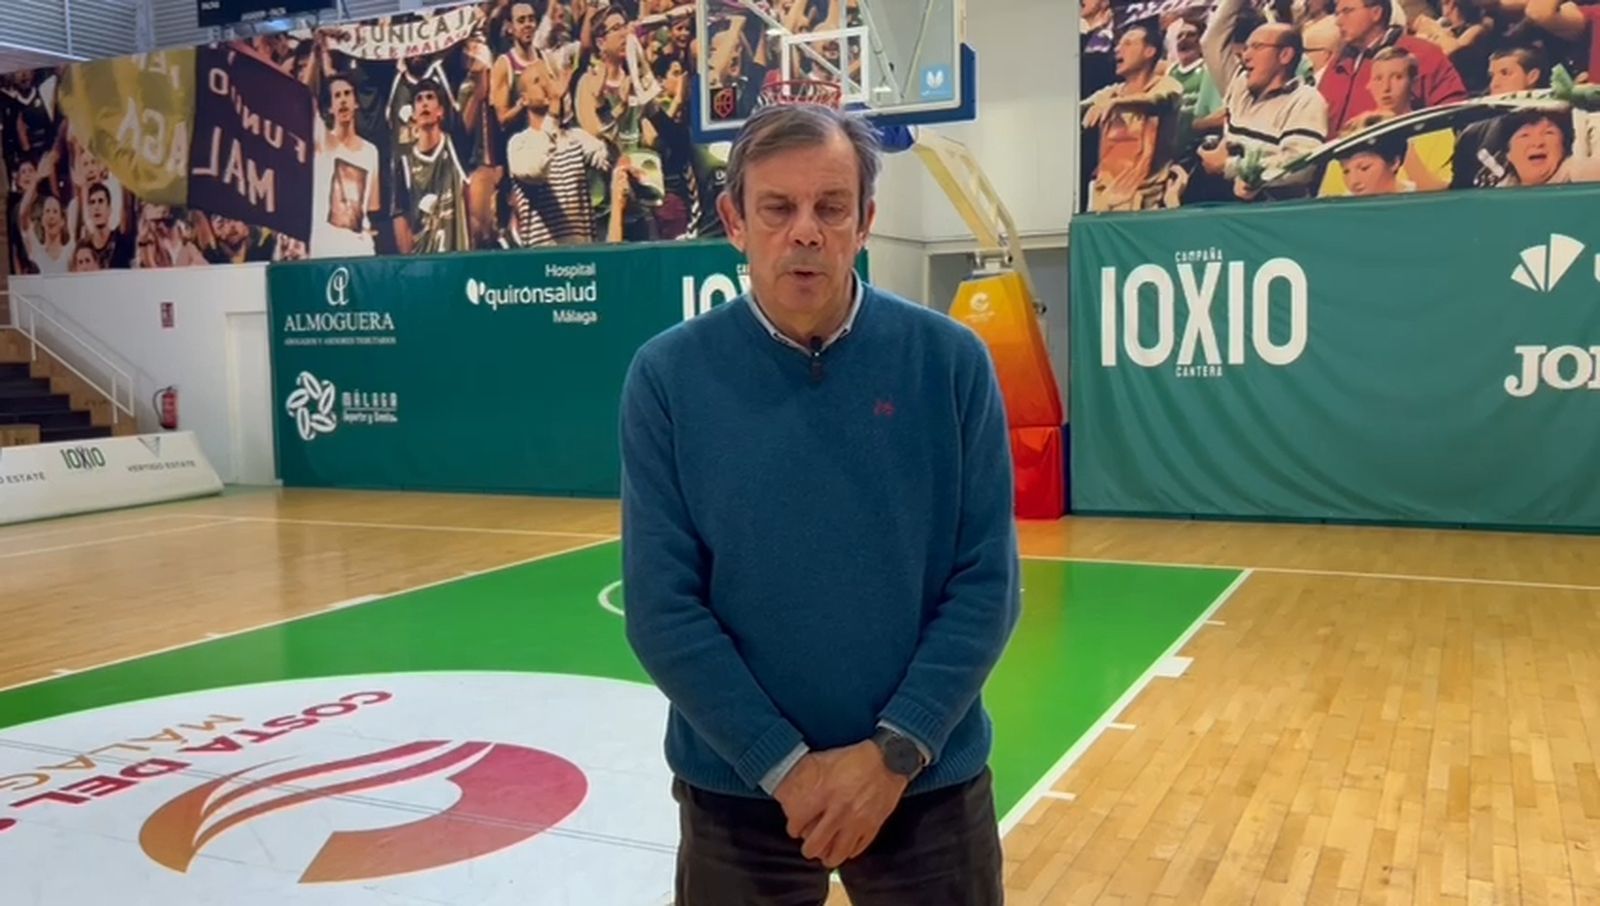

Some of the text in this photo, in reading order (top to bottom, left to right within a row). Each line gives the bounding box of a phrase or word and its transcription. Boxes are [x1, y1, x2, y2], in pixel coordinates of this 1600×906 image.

[1175, 247, 1223, 262] CAMPAÑA
[545, 263, 596, 279] Hospital
[284, 312, 395, 332] ALMOGUERA
[1175, 365, 1223, 378] CANTERA
[165, 460, 196, 471] ESTATE
[7, 471, 46, 484] ESTATE
[10, 690, 392, 808] COSTA DEL
